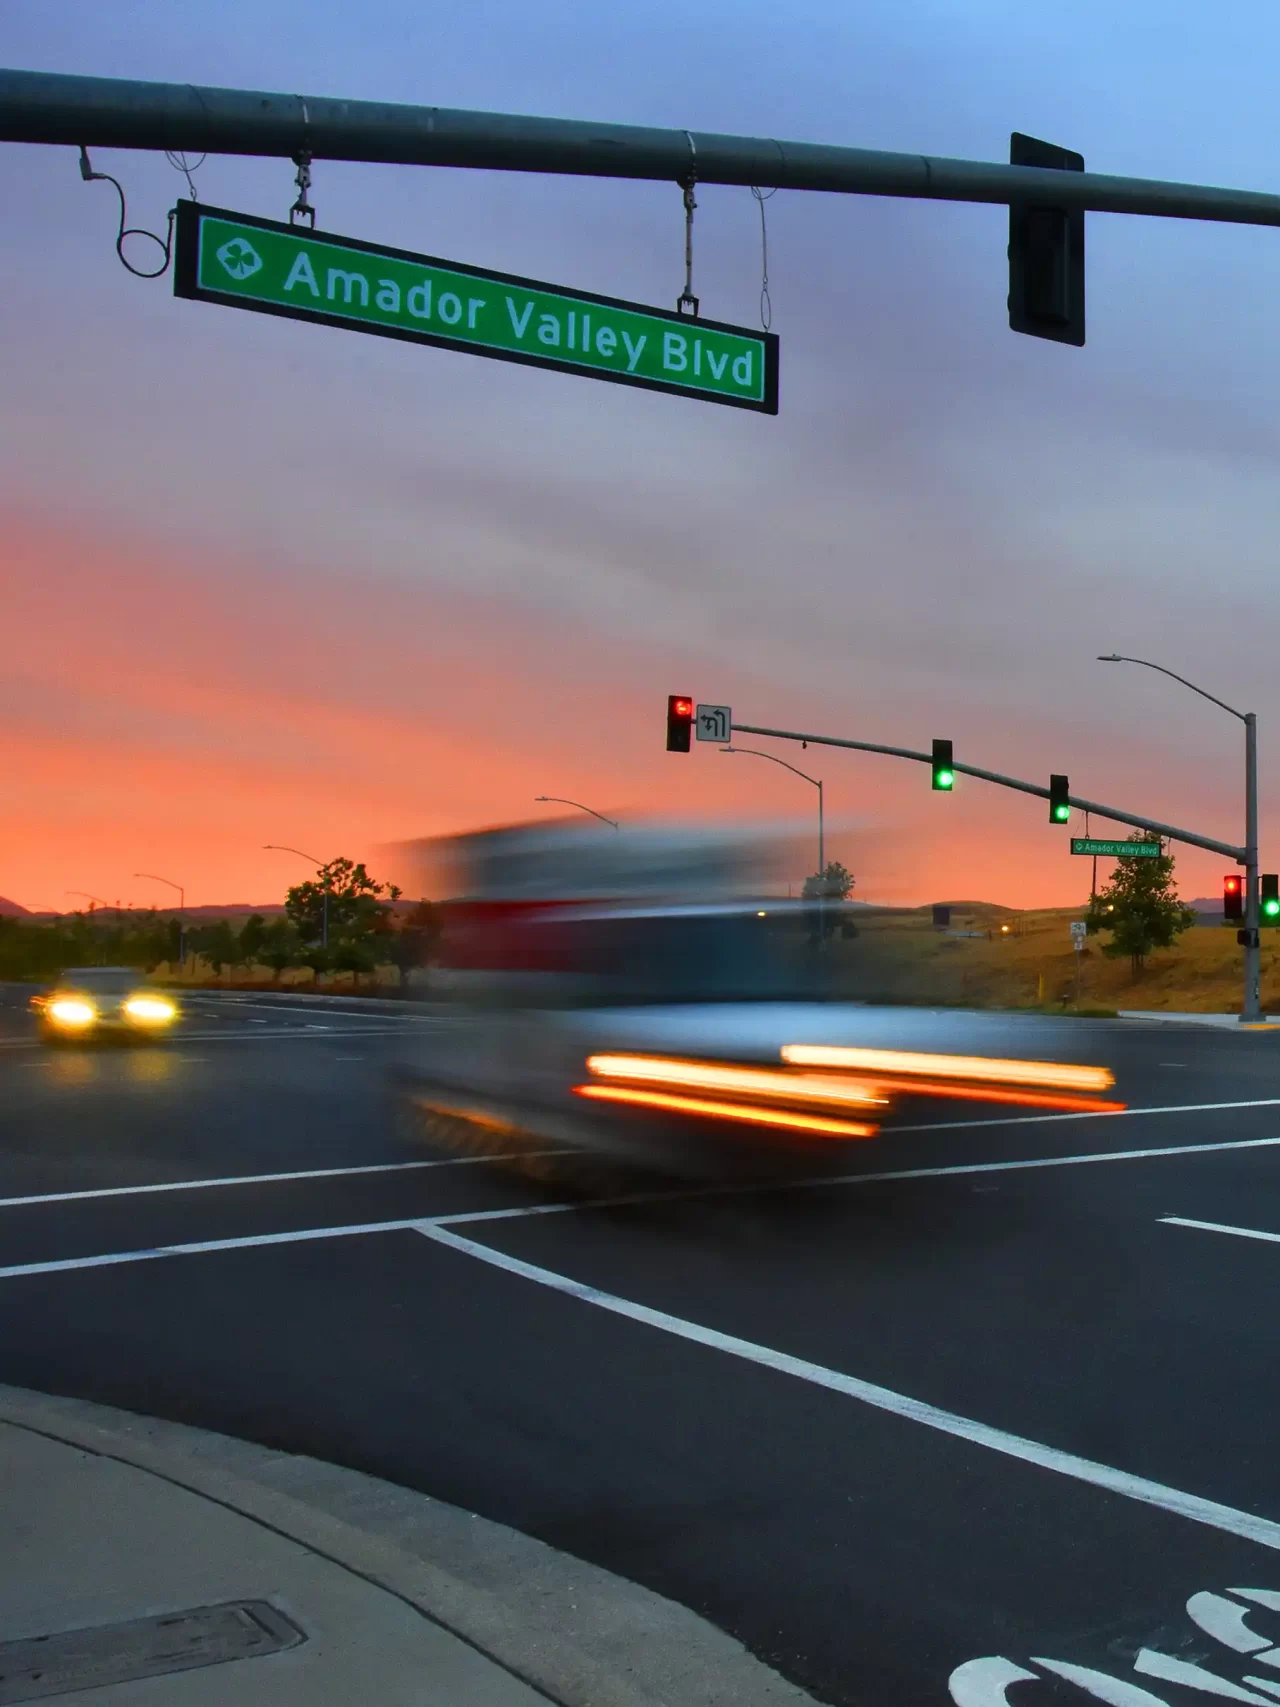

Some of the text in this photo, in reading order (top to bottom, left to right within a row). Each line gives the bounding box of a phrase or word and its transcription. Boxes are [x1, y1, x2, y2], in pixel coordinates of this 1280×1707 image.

[284, 252, 754, 387] Amador Valley Blvd
[1085, 843, 1157, 855] Amador Valley Blvd
